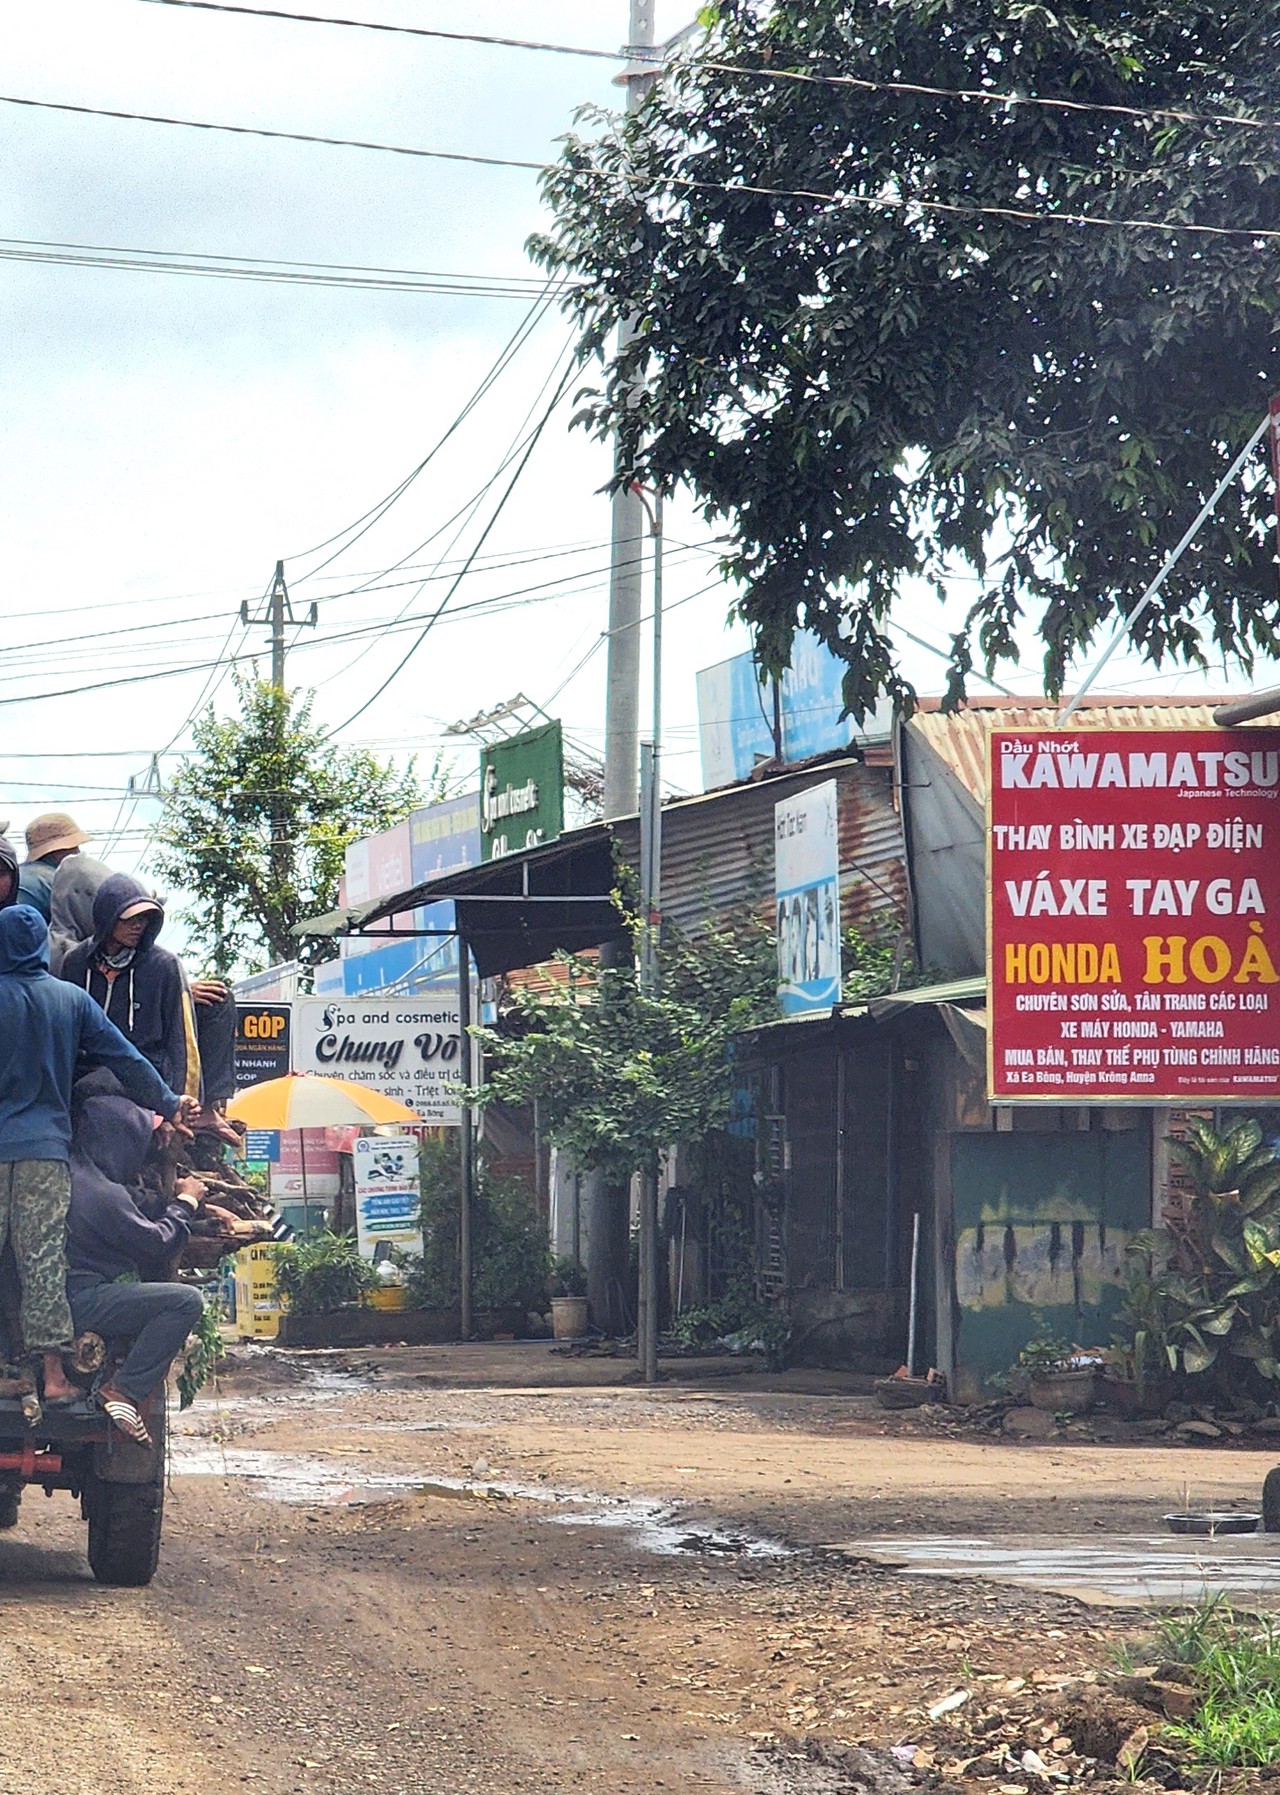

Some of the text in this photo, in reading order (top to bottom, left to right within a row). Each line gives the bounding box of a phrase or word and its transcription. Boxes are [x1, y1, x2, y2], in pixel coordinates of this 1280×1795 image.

[1001, 739, 1079, 753] Dầu Nhớt
[1001, 751, 1279, 788] KAWAMATSU
[1177, 788, 1279, 799] Japanese Technology
[993, 824, 1053, 850] THAY
[1059, 818, 1115, 850] BÌNH
[1120, 824, 1148, 849] XE
[1152, 823, 1201, 853] ĐẠP
[1126, 879, 1200, 916] TAY
[1205, 878, 1266, 915] GA
[1005, 920, 1280, 984] HONDA HOÀ
[1016, 991, 1068, 1011] CHUYÊN
[1071, 993, 1098, 1011] SƠN
[1134, 990, 1160, 1011] TÂN
[1163, 994, 1206, 1011] TRANG
[1209, 990, 1236, 1010] CÁC
[1239, 993, 1268, 1013] LOẠI
[244, 1011, 285, 1038] GÓP
[363, 1011, 389, 1023] and
[1060, 1021, 1078, 1038] XE
[1081, 1018, 1110, 1038] MÁY
[1113, 1021, 1158, 1038] HONDA
[1170, 1021, 1225, 1038] YAMAHA
[315, 1033, 404, 1069] Chung
[1004, 1049, 1034, 1066] MUA
[1037, 1046, 1068, 1067] BÁN,
[1071, 1049, 1103, 1066] THAY
[1105, 1044, 1130, 1066] THẾ
[1133, 1048, 1160, 1069] PHỤ
[1162, 1046, 1198, 1065] TÙNG
[1201, 1046, 1240, 1065] CHÍNH
[242, 1060, 277, 1068] NHANH
